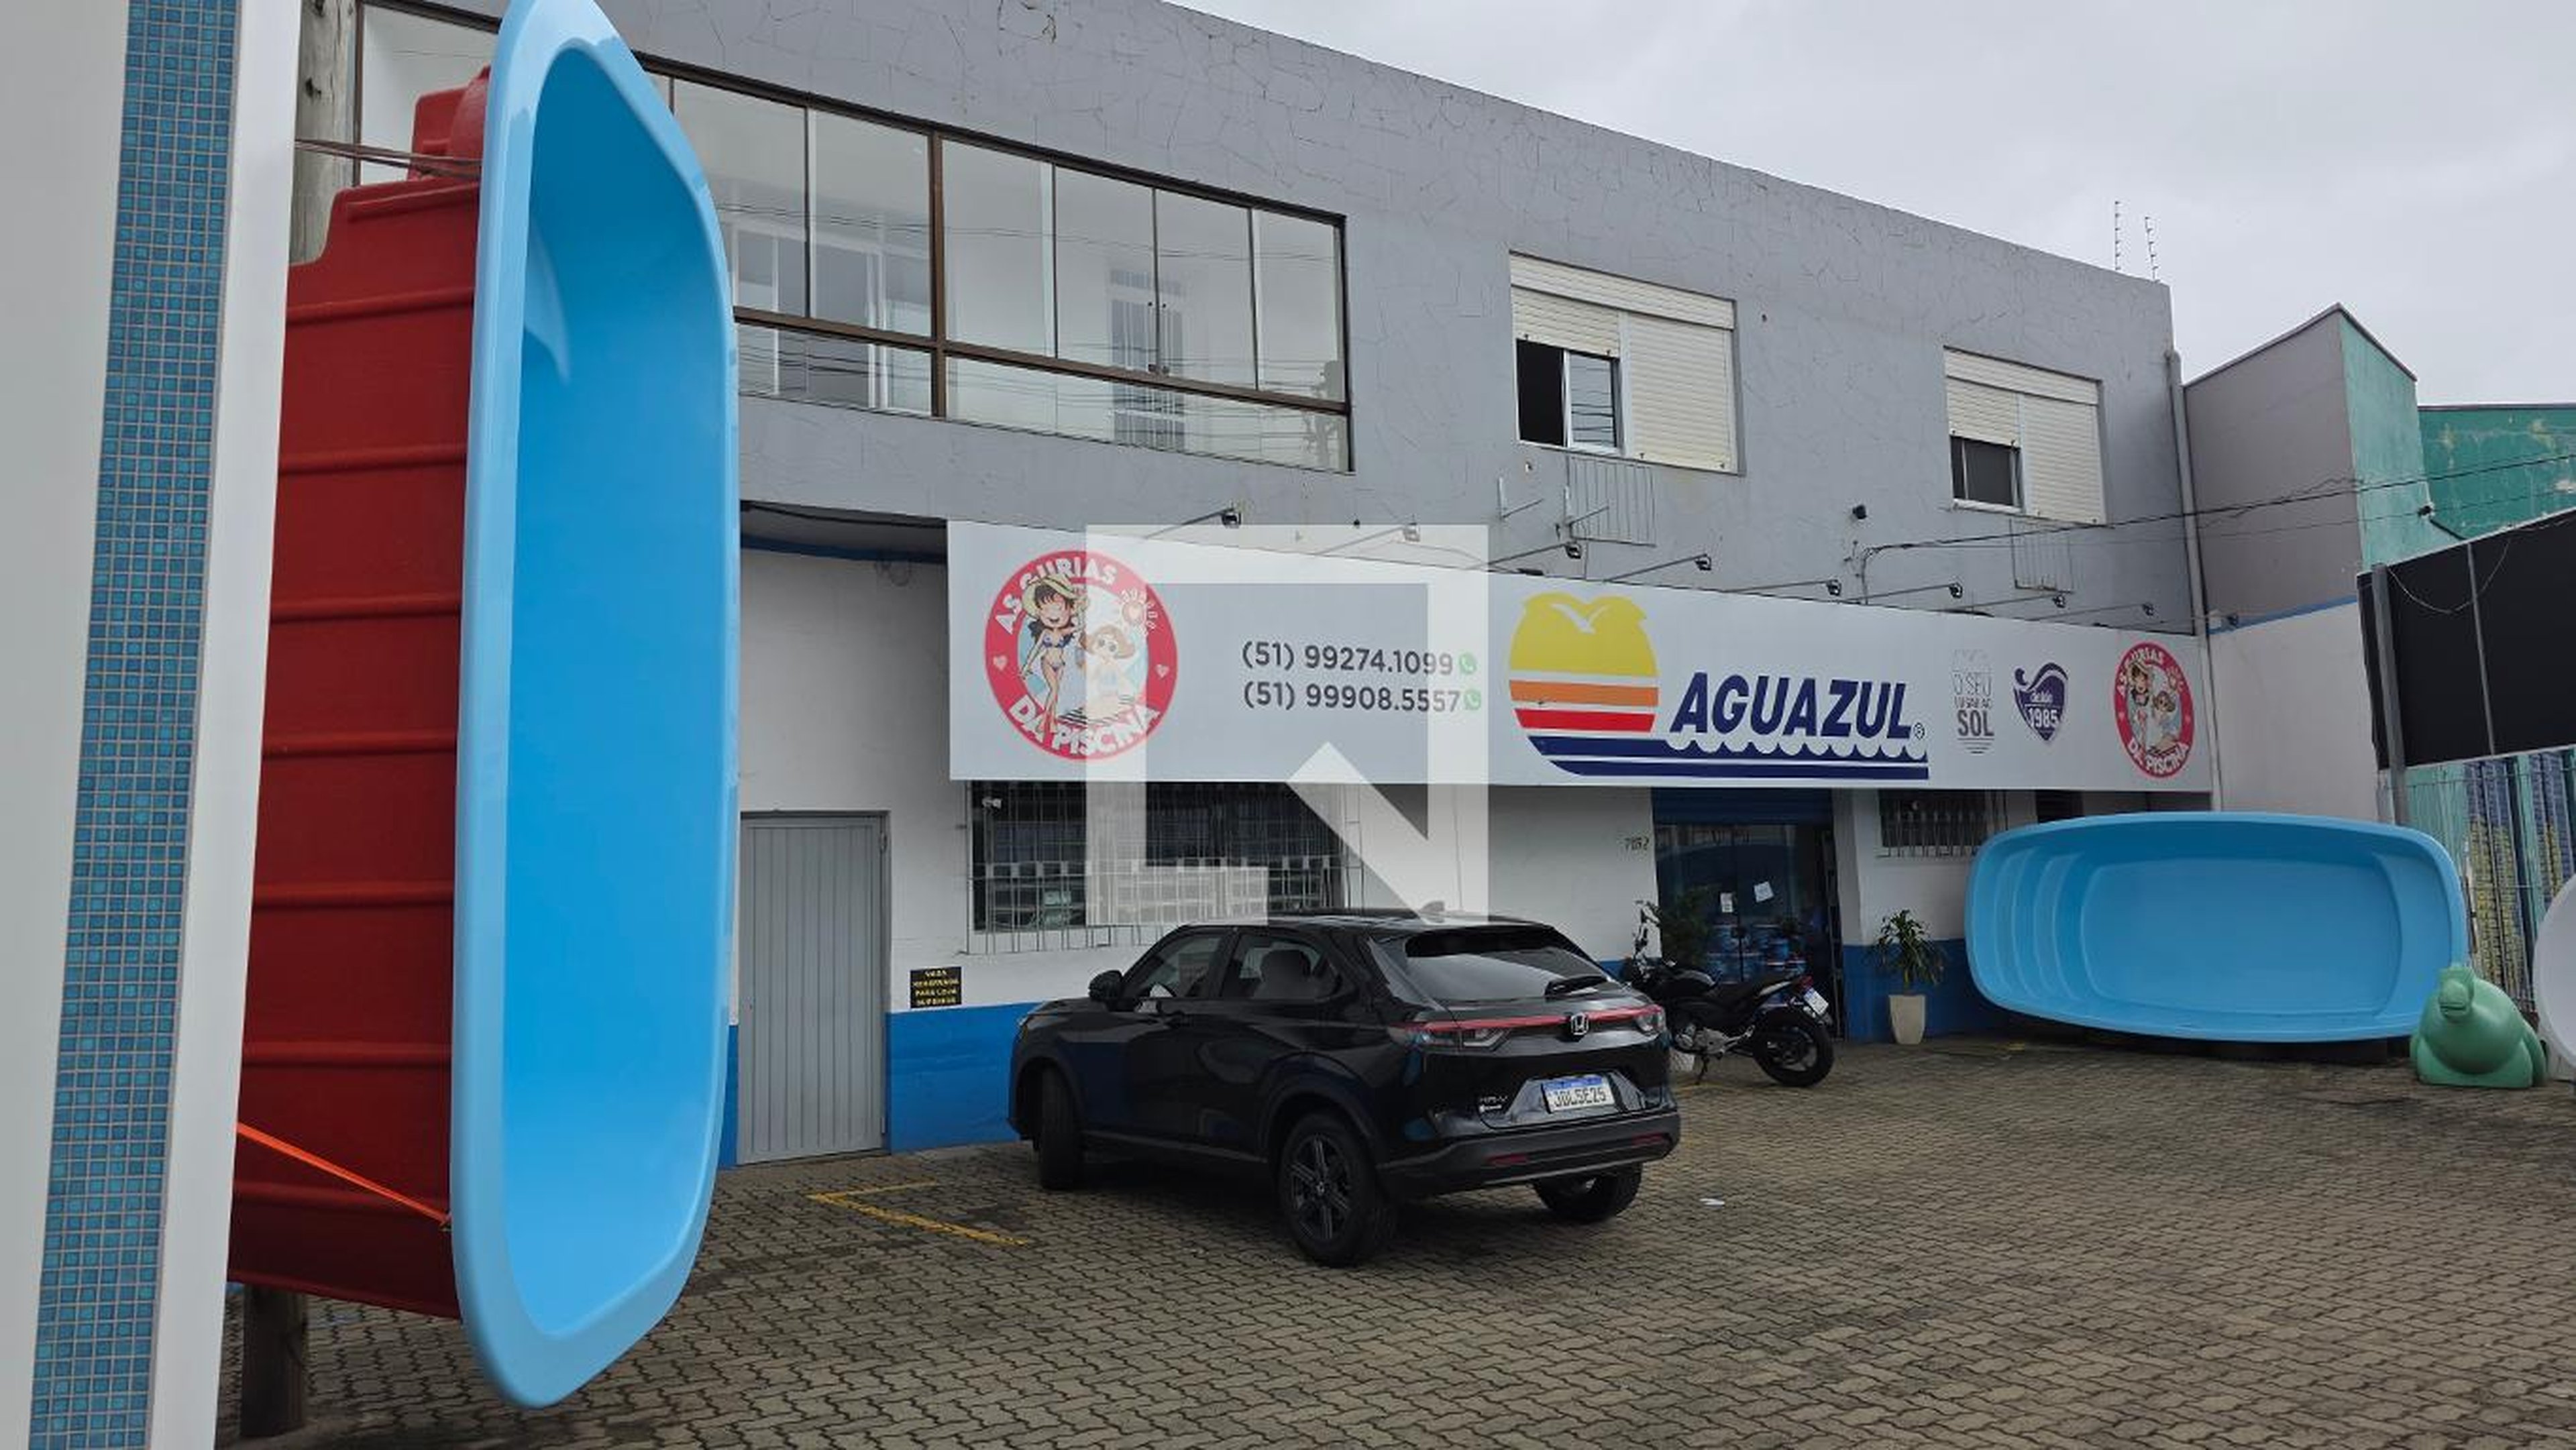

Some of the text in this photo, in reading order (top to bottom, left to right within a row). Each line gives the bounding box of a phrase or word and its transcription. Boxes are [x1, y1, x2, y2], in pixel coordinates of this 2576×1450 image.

[995, 593, 1023, 635] AS
[1242, 640, 1454, 675] (51) 99274.1099
[1244, 680, 1461, 713] (51) 99908.5557
[1670, 672, 1911, 738] AGUAZUL
[1052, 704, 1161, 756] PISCINA
[1957, 710, 1995, 737] SOL
[2029, 708, 2059, 728] 1985
